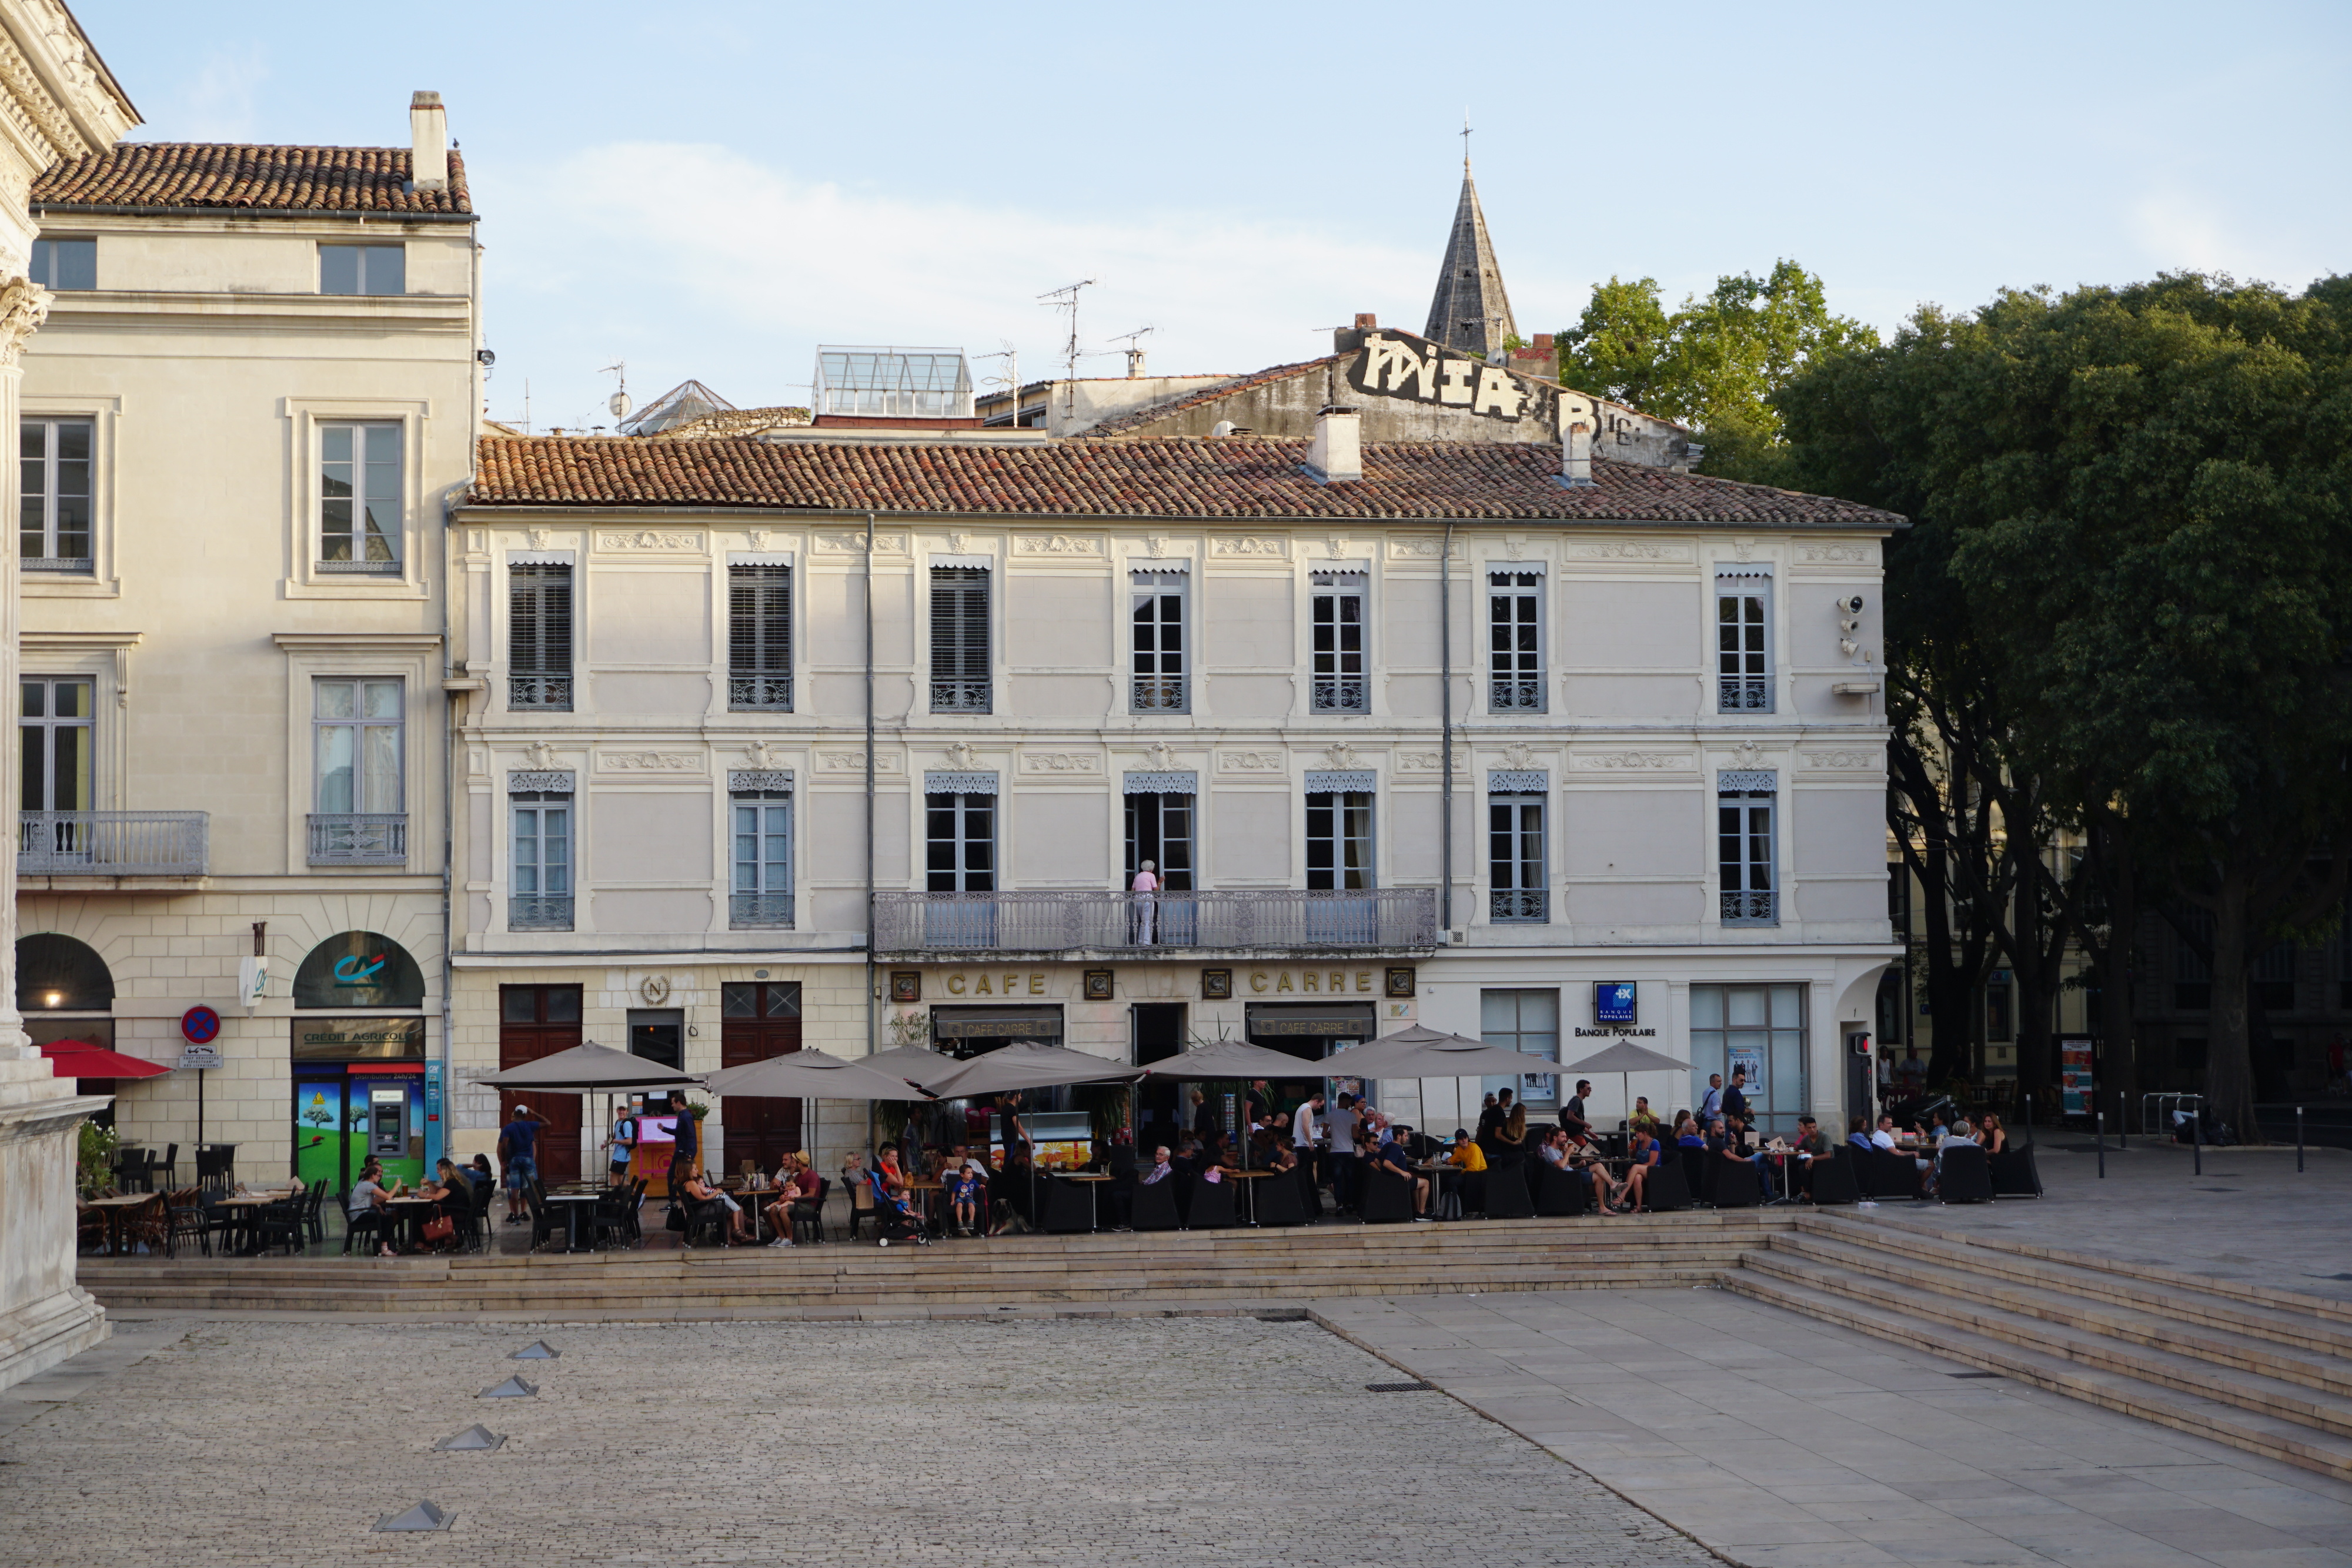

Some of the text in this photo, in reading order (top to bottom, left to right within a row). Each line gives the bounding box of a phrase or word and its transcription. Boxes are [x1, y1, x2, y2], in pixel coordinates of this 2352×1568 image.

[948, 974, 1045, 994] CAFE
[1250, 971, 1371, 991] CARRE
[649, 982, 661, 995] N
[967, 1024, 1032, 1036] CAFE CARRE
[1280, 1022, 1344, 1034] CAFE CARRE
[1575, 1027, 1656, 1037] BANQUE POPULAIRE
[304, 1032, 411, 1041] CRÉDIT AGRICOLE
